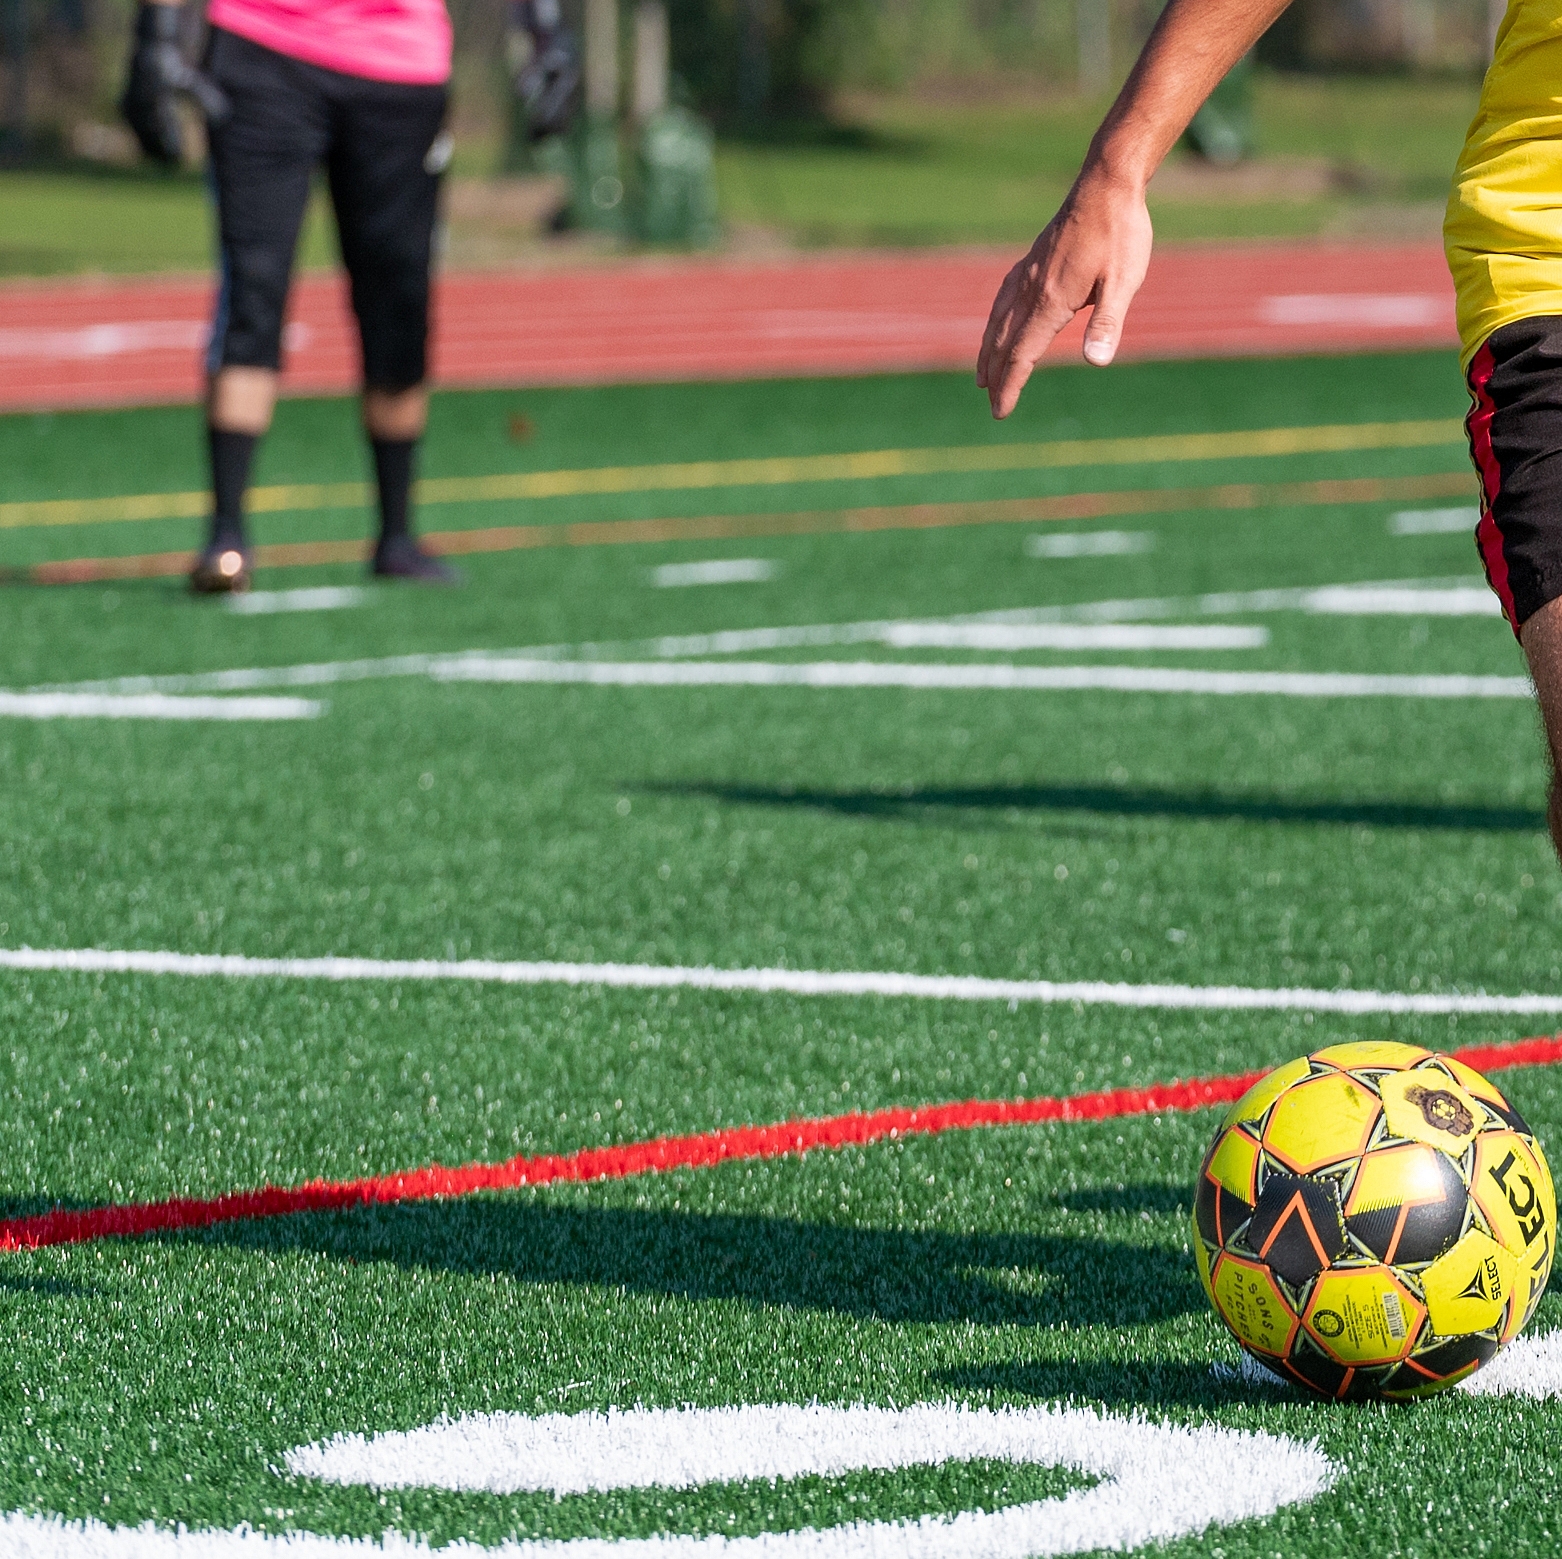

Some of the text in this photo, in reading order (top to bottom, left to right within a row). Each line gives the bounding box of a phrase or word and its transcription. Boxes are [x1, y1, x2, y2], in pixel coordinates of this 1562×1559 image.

[1484, 1255, 1502, 1301] SELECT
[1234, 1271, 1254, 1341] PITCHES
[1248, 1282, 1275, 1331] SONS
